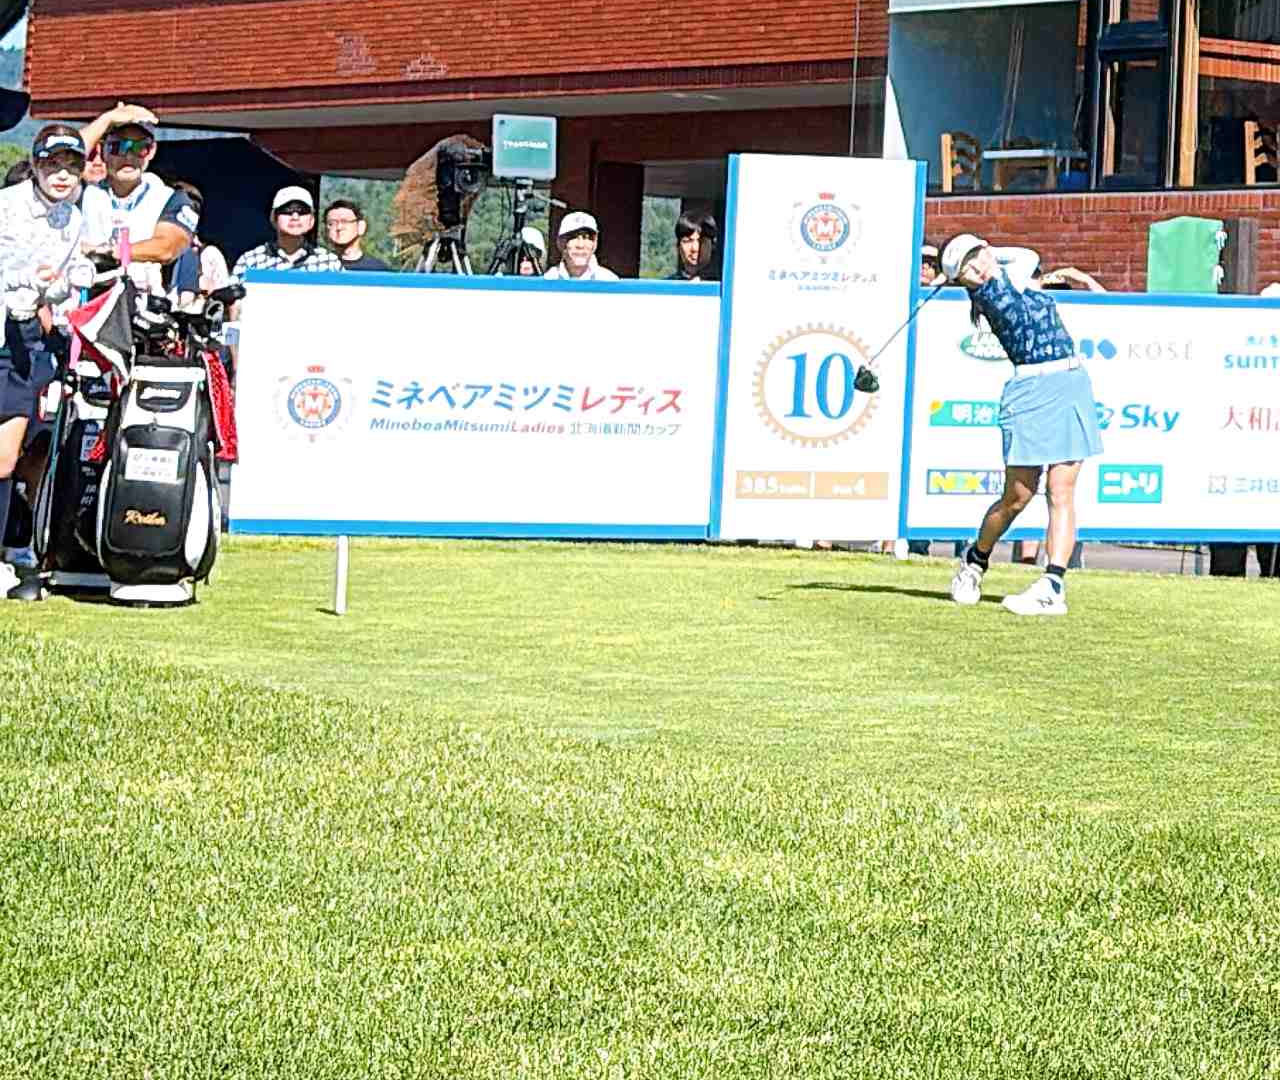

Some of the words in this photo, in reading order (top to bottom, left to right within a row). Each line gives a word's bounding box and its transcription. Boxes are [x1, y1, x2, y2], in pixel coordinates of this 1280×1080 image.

[369, 378, 683, 416] ミネベアミツミレディス
[784, 352, 855, 420] 10
[369, 417, 566, 434] MinebeaMitsumiLadies
[951, 403, 1000, 424] 明治
[1119, 404, 1181, 432] Sky
[1100, 470, 1160, 496] ニトリ
